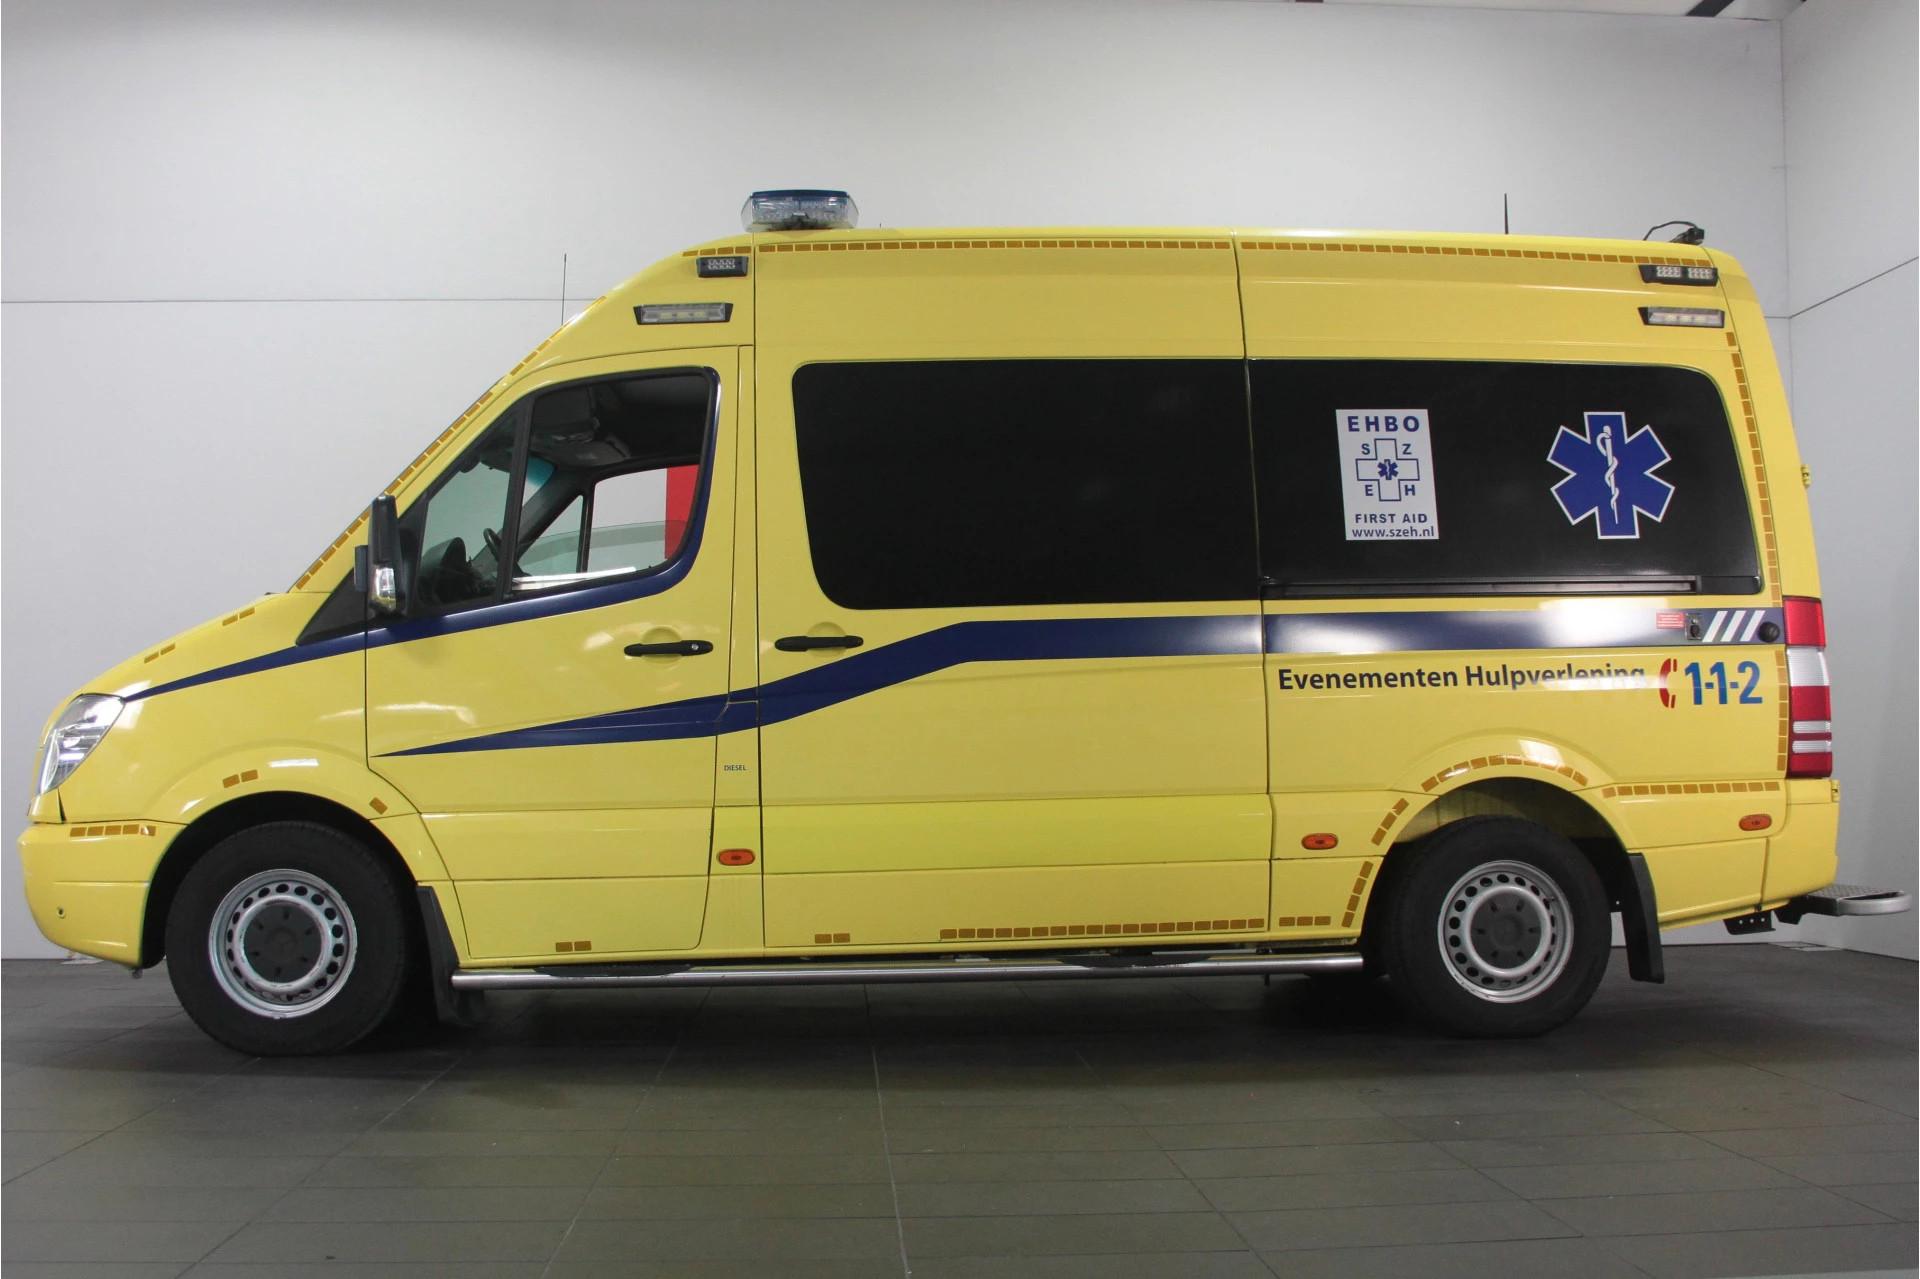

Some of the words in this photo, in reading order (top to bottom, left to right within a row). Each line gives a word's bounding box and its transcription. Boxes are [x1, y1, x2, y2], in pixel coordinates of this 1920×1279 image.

[1347, 415, 1420, 432] EHBO
[1361, 443, 1371, 455] S
[1402, 443, 1412, 455] Z
[1364, 484, 1374, 496] E
[1404, 484, 1416, 496] H
[1355, 513, 1396, 523] FIRST
[1402, 513, 1428, 523] AID
[1352, 526, 1435, 537] www.szeh.nl
[1278, 668, 1458, 690] Evenementen
[1684, 660, 1763, 705] 1-1-2
